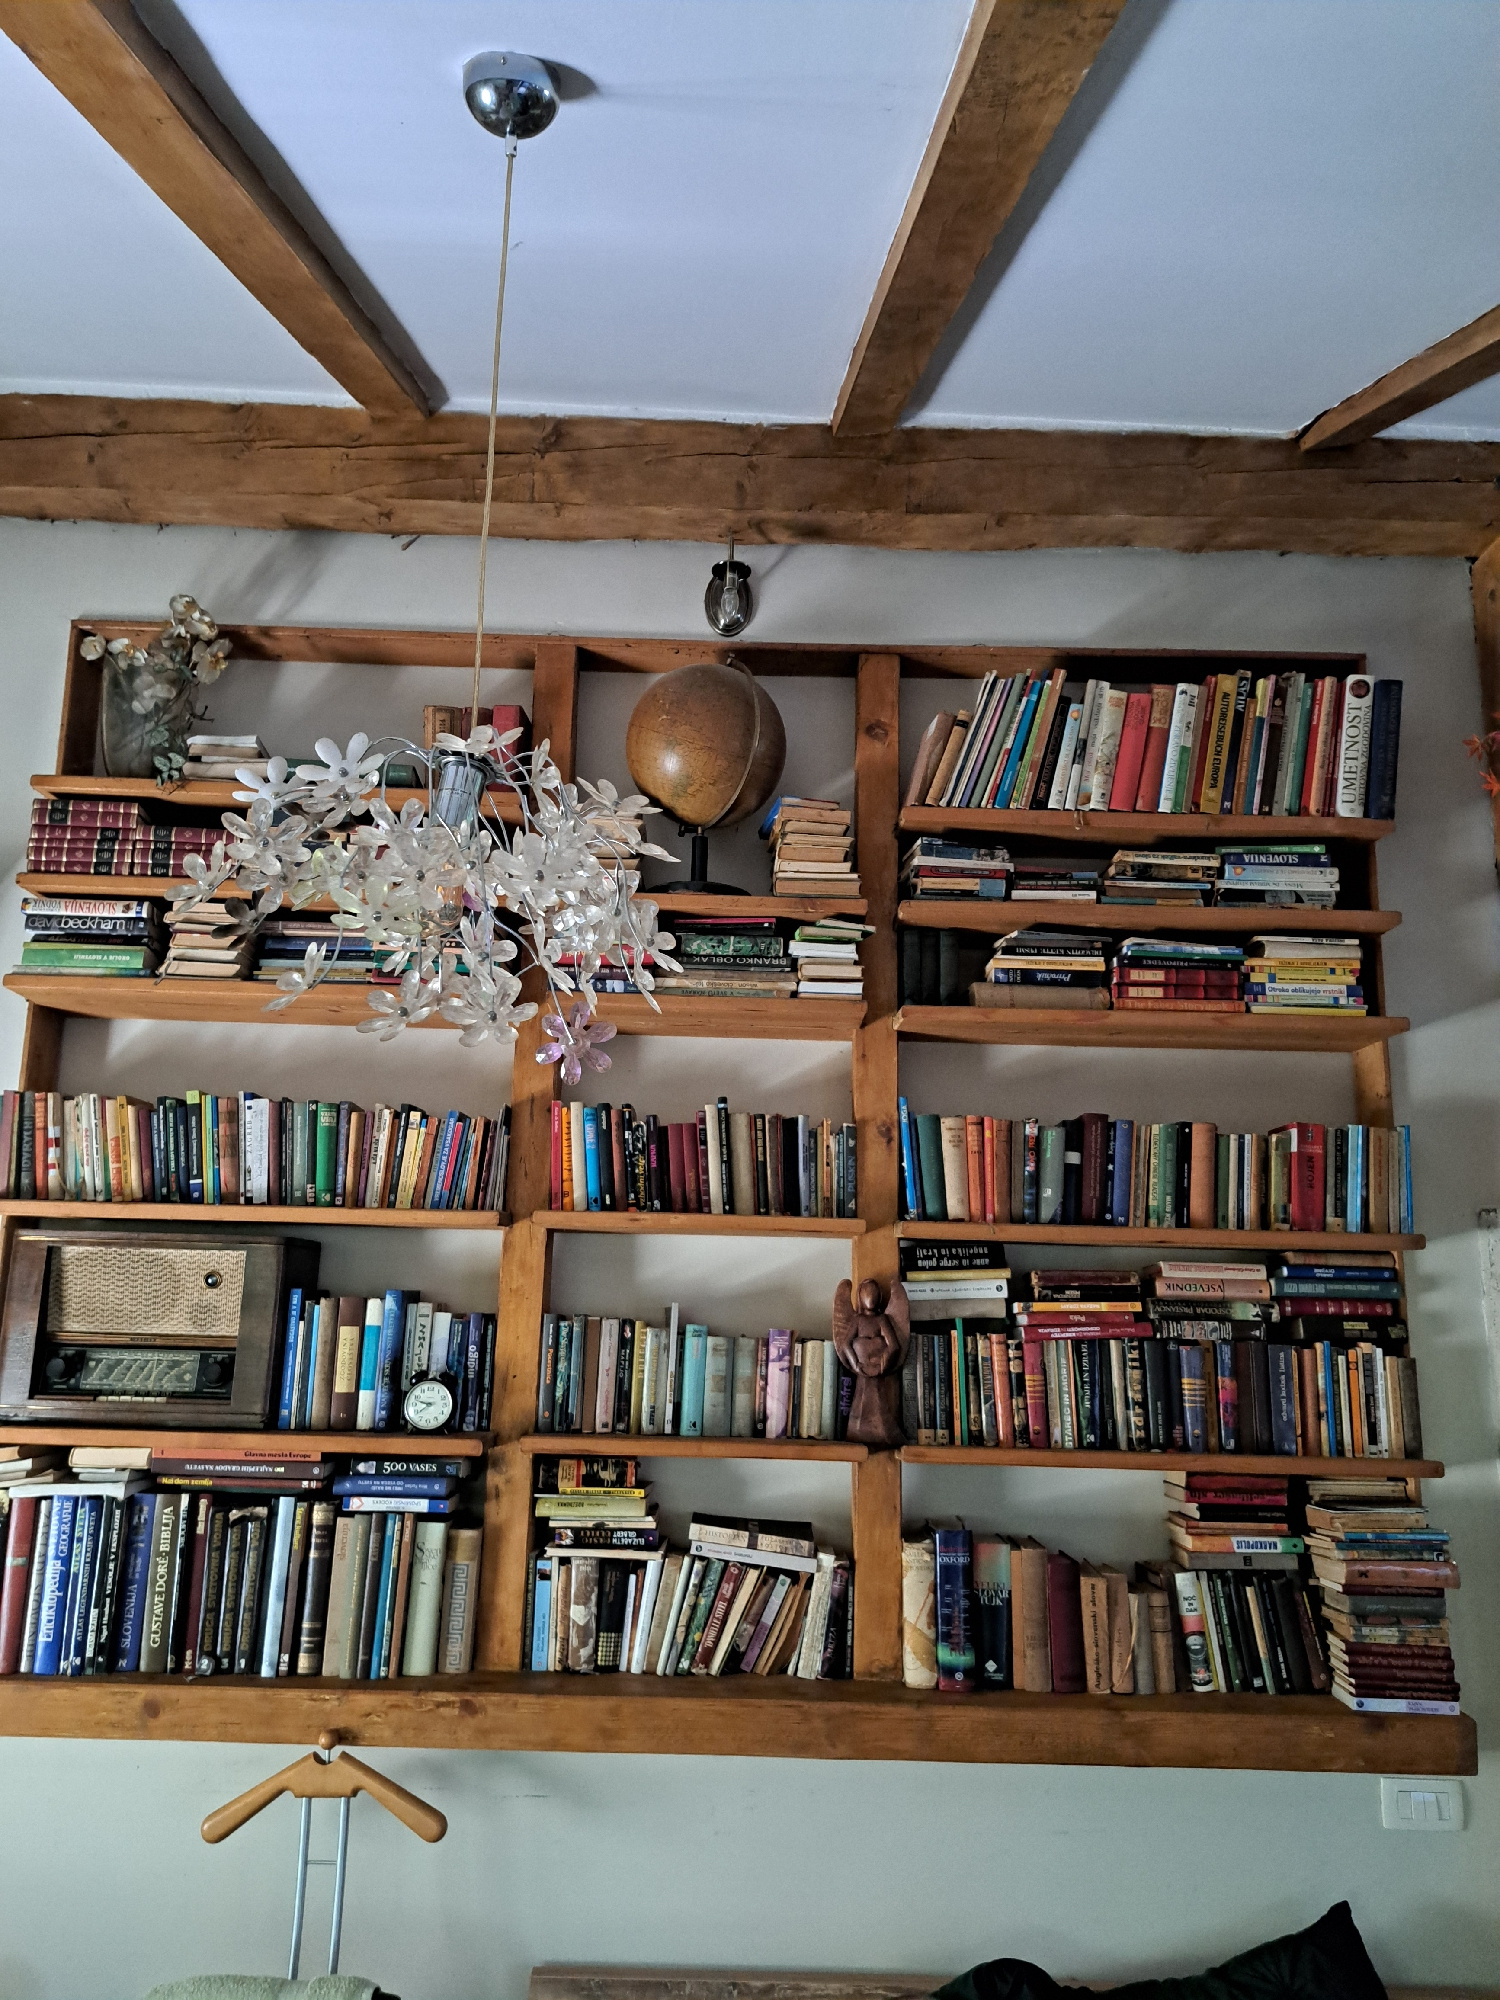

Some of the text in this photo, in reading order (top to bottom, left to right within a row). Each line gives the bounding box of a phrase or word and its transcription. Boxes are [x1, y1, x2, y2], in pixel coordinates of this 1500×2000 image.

[1237, 678, 1250, 712] ATLAS
[1209, 692, 1231, 789] AUTOREISEBUCH EUROPA
[1342, 704, 1363, 805] UMETNOST
[1359, 704, 1372, 807] SVETOVNA ZGODOVINA
[1243, 853, 1299, 863] SLOVENIJA
[30, 898, 62, 909] VODNIK
[64, 900, 117, 915] SLOVENIJA
[693, 955, 787, 965] BRANKO OBLAK
[1066, 948, 1102, 956] DRAGOTIN
[1036, 972, 1072, 982] Priročnik
[1322, 987, 1347, 995] vrstniki
[635, 1155, 645, 1207] vzhodni veter
[917, 1247, 939, 1258] kralj
[939, 1258, 959, 1267] serge
[950, 1246, 989, 1256] angelika
[917, 1259, 937, 1269] golon
[1164, 1281, 1223, 1293] VSEVEDNIK
[1154, 1305, 1193, 1316] PRSTANOV
[340, 1337, 348, 1382] ZGODOVINA
[467, 1345, 479, 1379] indigo
[1063, 1393, 1070, 1405] IN
[1064, 1407, 1073, 1448] STAREC
[382, 1461, 437, 1474] 500 VASES
[176, 1477, 213, 1487] dom zemlja
[59, 1500, 73, 1557] GEOGRAFIJE
[72, 1507, 86, 1574] ATLAS SVETA
[339, 1522, 351, 1562] slovenija
[1235, 1540, 1278, 1550] NARKOPOLIS
[939, 1556, 971, 1564] OXFORD
[76, 1618, 84, 1641] ATLAS
[89, 1511, 97, 1532] SVETA
[150, 1505, 175, 1648] GUSTAVE DORÉ BIBLIJA
[226, 1551, 238, 1608] SVETOVNA
[39, 1559, 66, 1642] Enciklopedija
[200, 1511, 224, 1669] 2 DRUGA SVETOVNA VOJNA
[974, 1589, 1010, 1599] SLOVAR
[121, 1583, 137, 1648] SLOVENIJA
[705, 1599, 726, 1648] DANIELLE STEEL
[222, 1612, 232, 1652] DRUGA
[240, 1612, 252, 1652] DRUGA
[239, 1658, 245, 1669] 1
